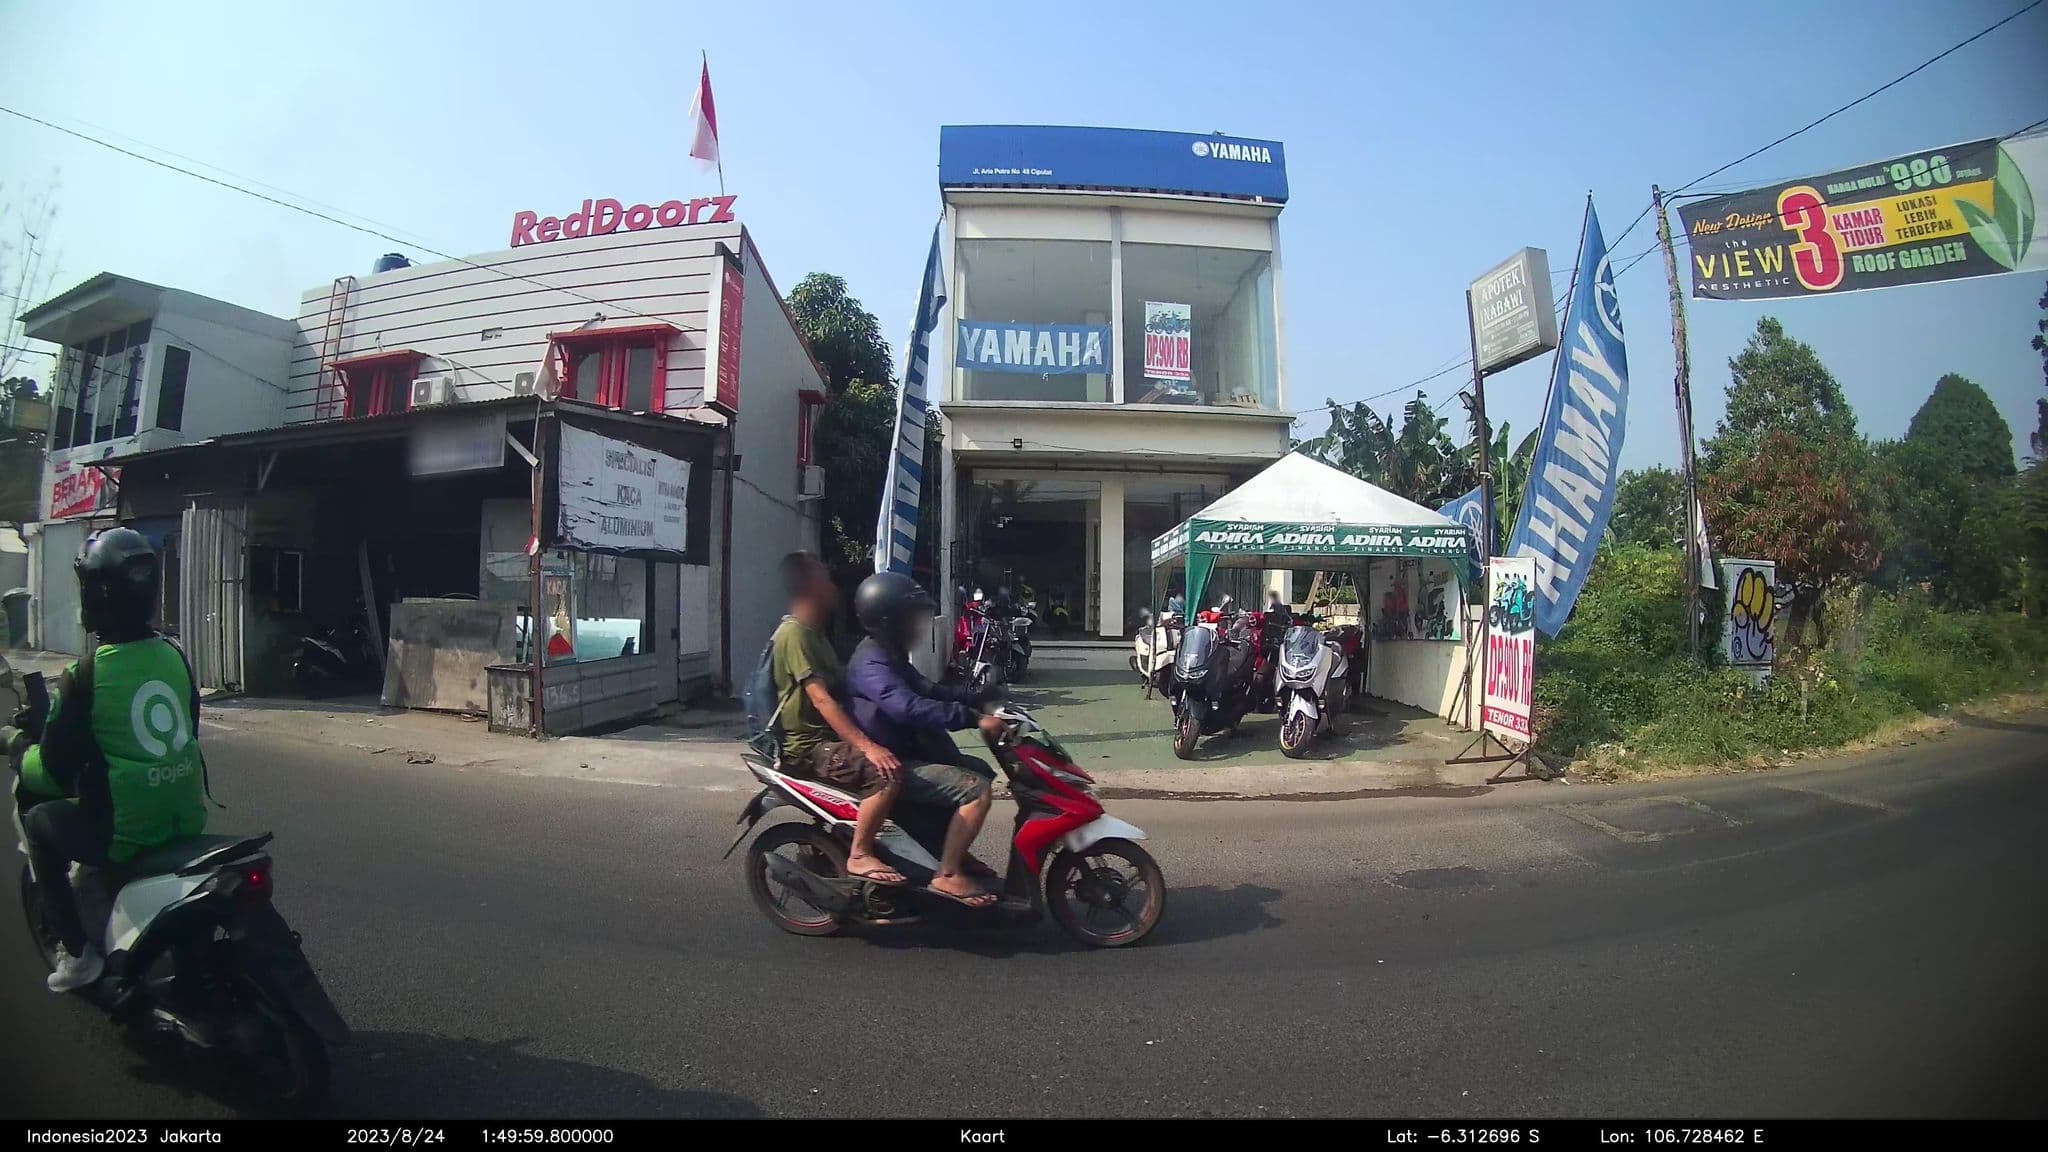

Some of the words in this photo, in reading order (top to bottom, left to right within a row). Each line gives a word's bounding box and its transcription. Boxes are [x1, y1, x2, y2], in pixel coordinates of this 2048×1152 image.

[1209, 142, 1272, 164] YAMAHA
[1896, 194, 1938, 212] LOKASI
[510, 195, 738, 248] RedDoorz
[1692, 218, 1723, 236] New
[1725, 212, 1773, 231] Design
[1832, 207, 1883, 231] KAMAR
[1904, 208, 1937, 225] LEBIH
[1778, 187, 1843, 290] 3
[1840, 227, 1884, 248] TIDUR
[1896, 218, 1953, 240] TERDEPAN
[1725, 240, 1747, 248] the
[1695, 245, 1783, 278] VIEW
[1852, 252, 1896, 273] ROOF
[1898, 242, 1967, 269] GARDEN
[1482, 268, 1520, 303] APOTEK
[1698, 277, 1791, 291] AESTHETIC
[1483, 289, 1523, 322] NABAWI
[960, 326, 1103, 367] YAMAHA
[617, 485, 641, 505] KACA
[601, 517, 654, 537] ALUMINIUM
[1195, 532, 1264, 543] ADIRA
[1269, 533, 1335, 545] ADIRA
[1340, 535, 1403, 546] ADIRA
[1407, 536, 1466, 547] ADIRA
[1488, 708, 1514, 728] TENOR
[147, 757, 193, 787] gojek
